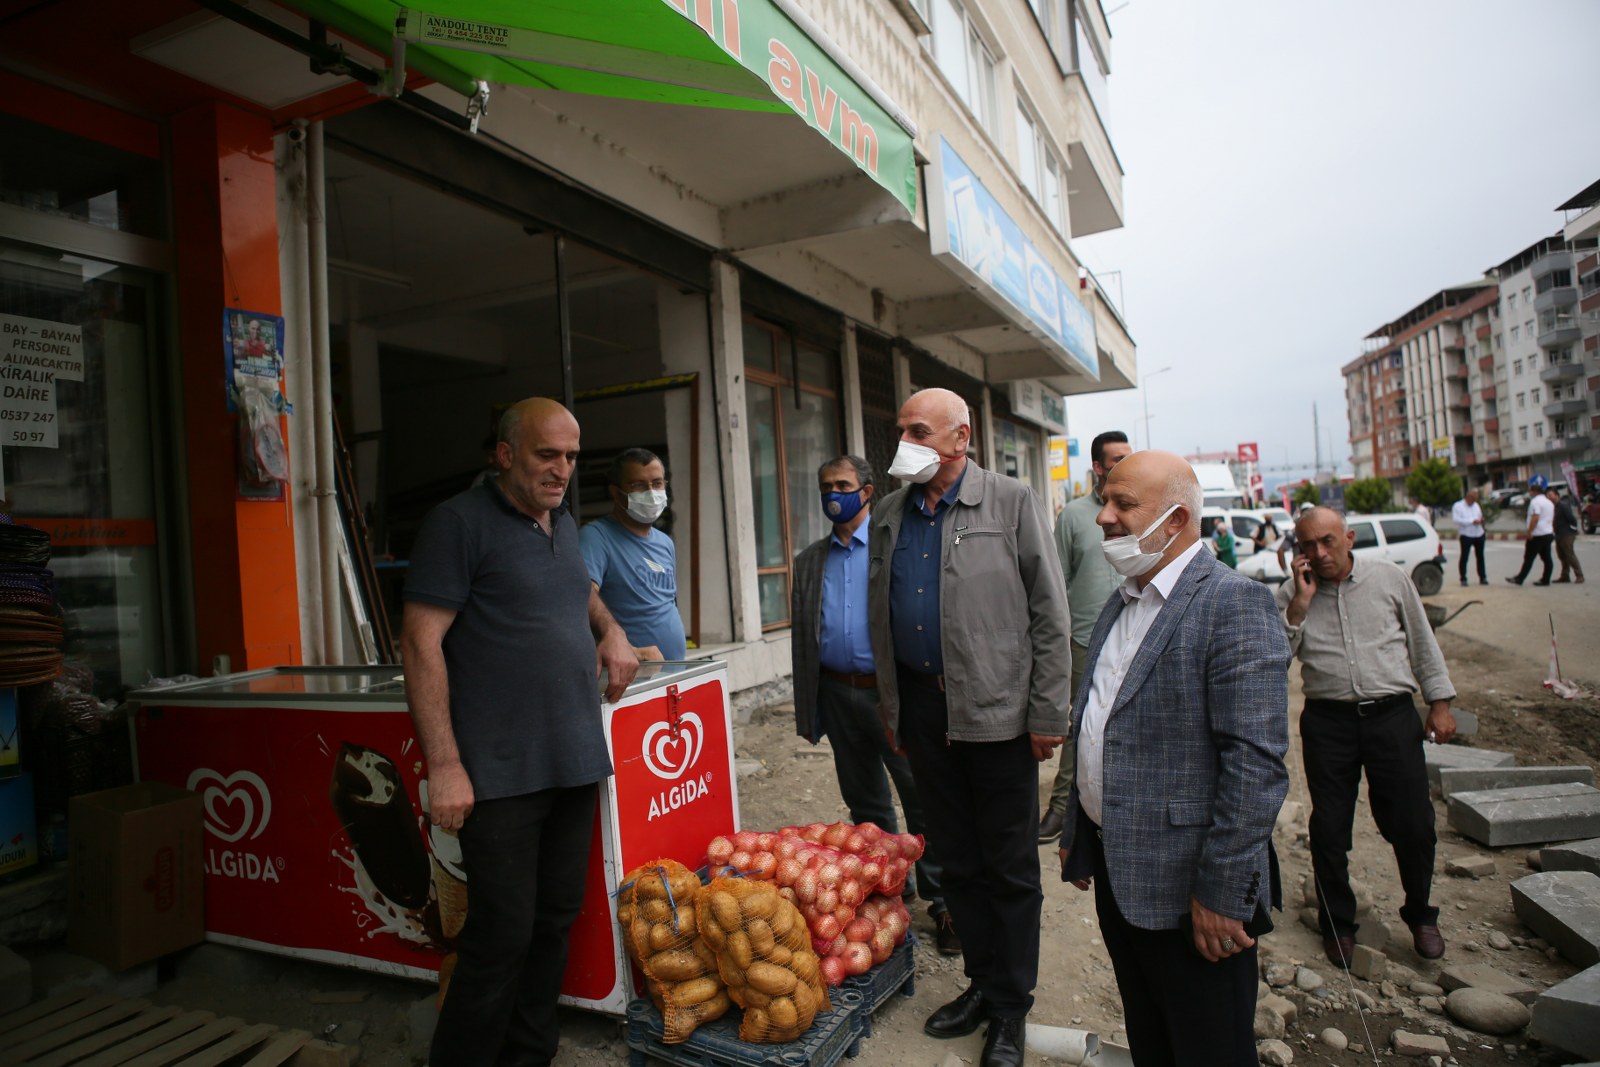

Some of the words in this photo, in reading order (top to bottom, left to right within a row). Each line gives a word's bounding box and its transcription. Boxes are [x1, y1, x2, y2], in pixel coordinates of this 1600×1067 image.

[427, 17, 475, 32] ANADOLU
[476, 24, 509, 38] TENTE
[768, 38, 879, 177] avm
[3, 323, 28, 335] BAY
[41, 329, 80, 343] BAYAN
[13, 339, 72, 356] PERSONEL
[3, 353, 82, 373] ALINACAKTIR
[0, 364, 54, 384] KİRALIK
[3, 385, 49, 402] DAİRE
[0, 409, 30, 421] 0537
[32, 412, 55, 423] 247
[13, 431, 27, 441] 50
[30, 432, 45, 442] 97
[205, 848, 280, 884] LGiDA
